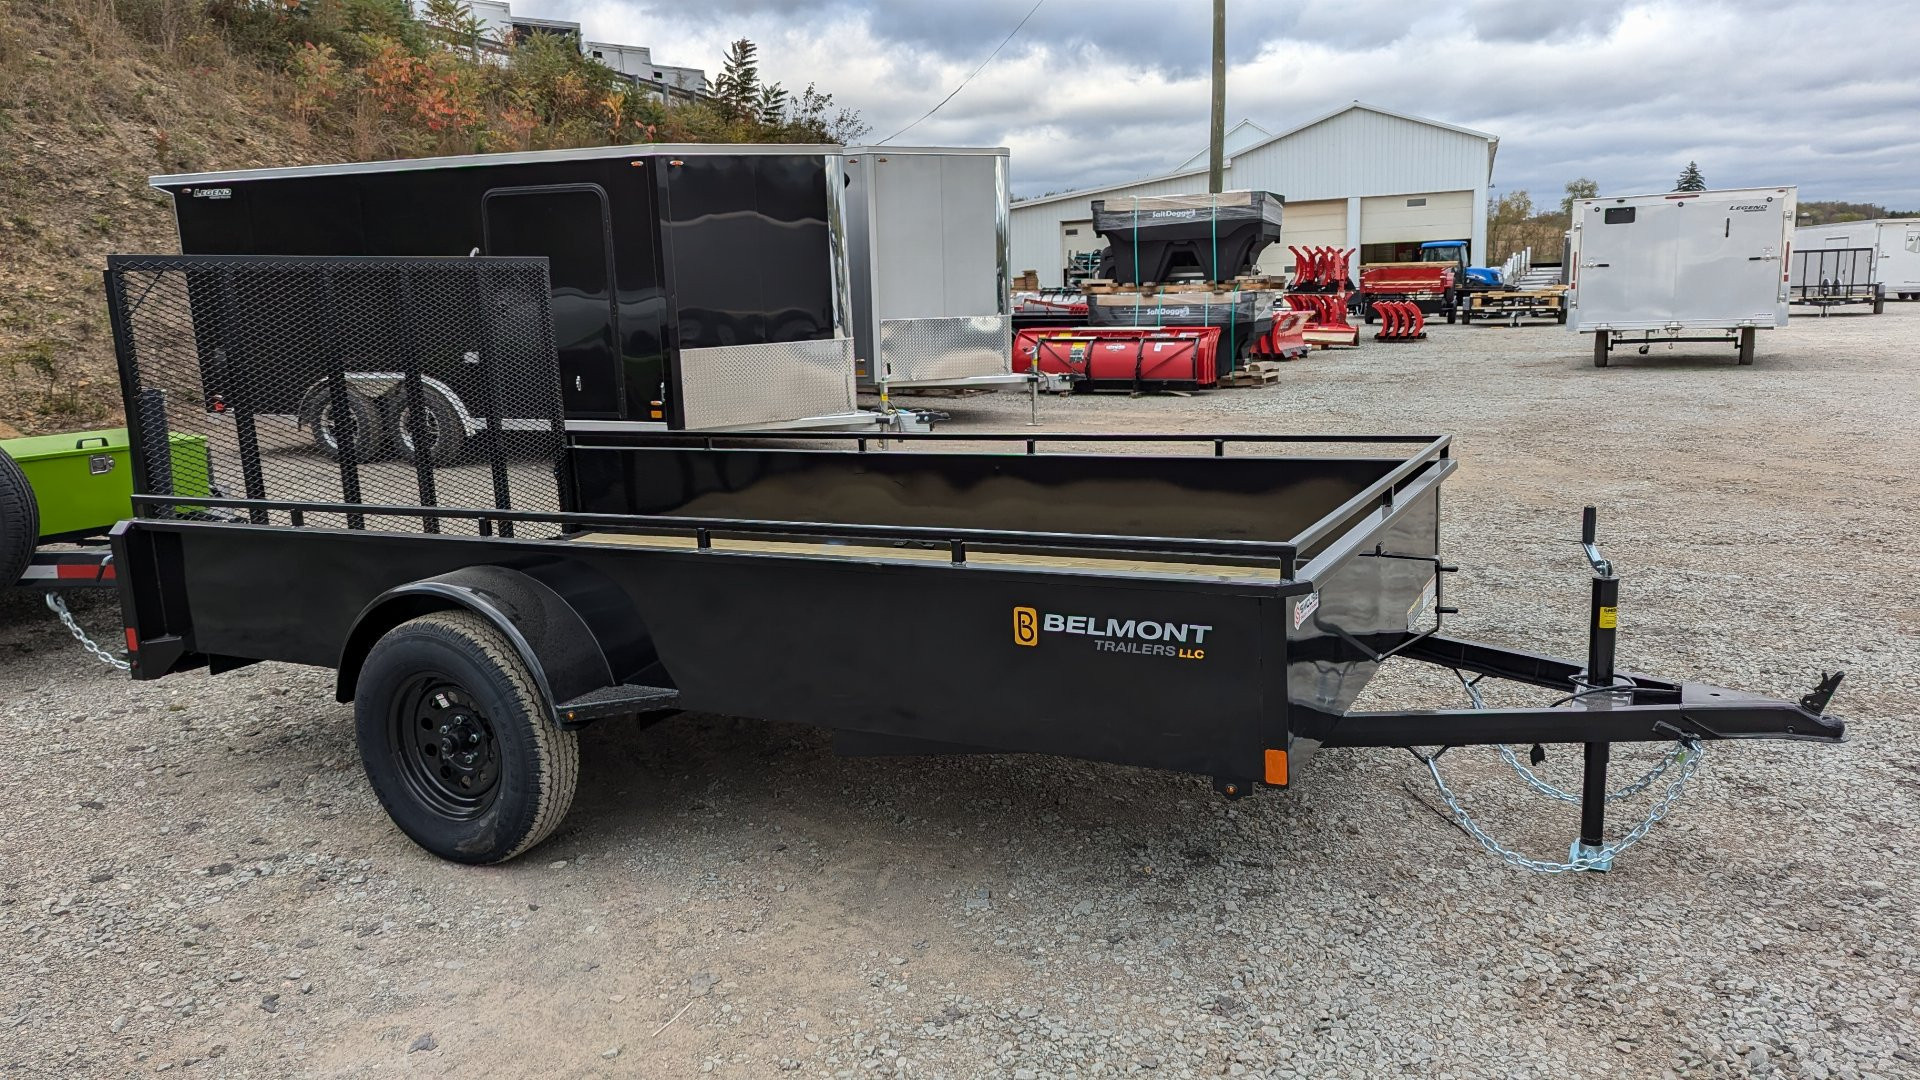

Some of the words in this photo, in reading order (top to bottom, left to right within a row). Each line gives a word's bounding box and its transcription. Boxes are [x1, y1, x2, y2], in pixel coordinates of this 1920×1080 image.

[193, 188, 232, 197] LEGEND
[1043, 613, 1213, 643] BELMONT
[1094, 639, 1176, 657] TRAILERS
[1178, 648, 1205, 659] LLC
